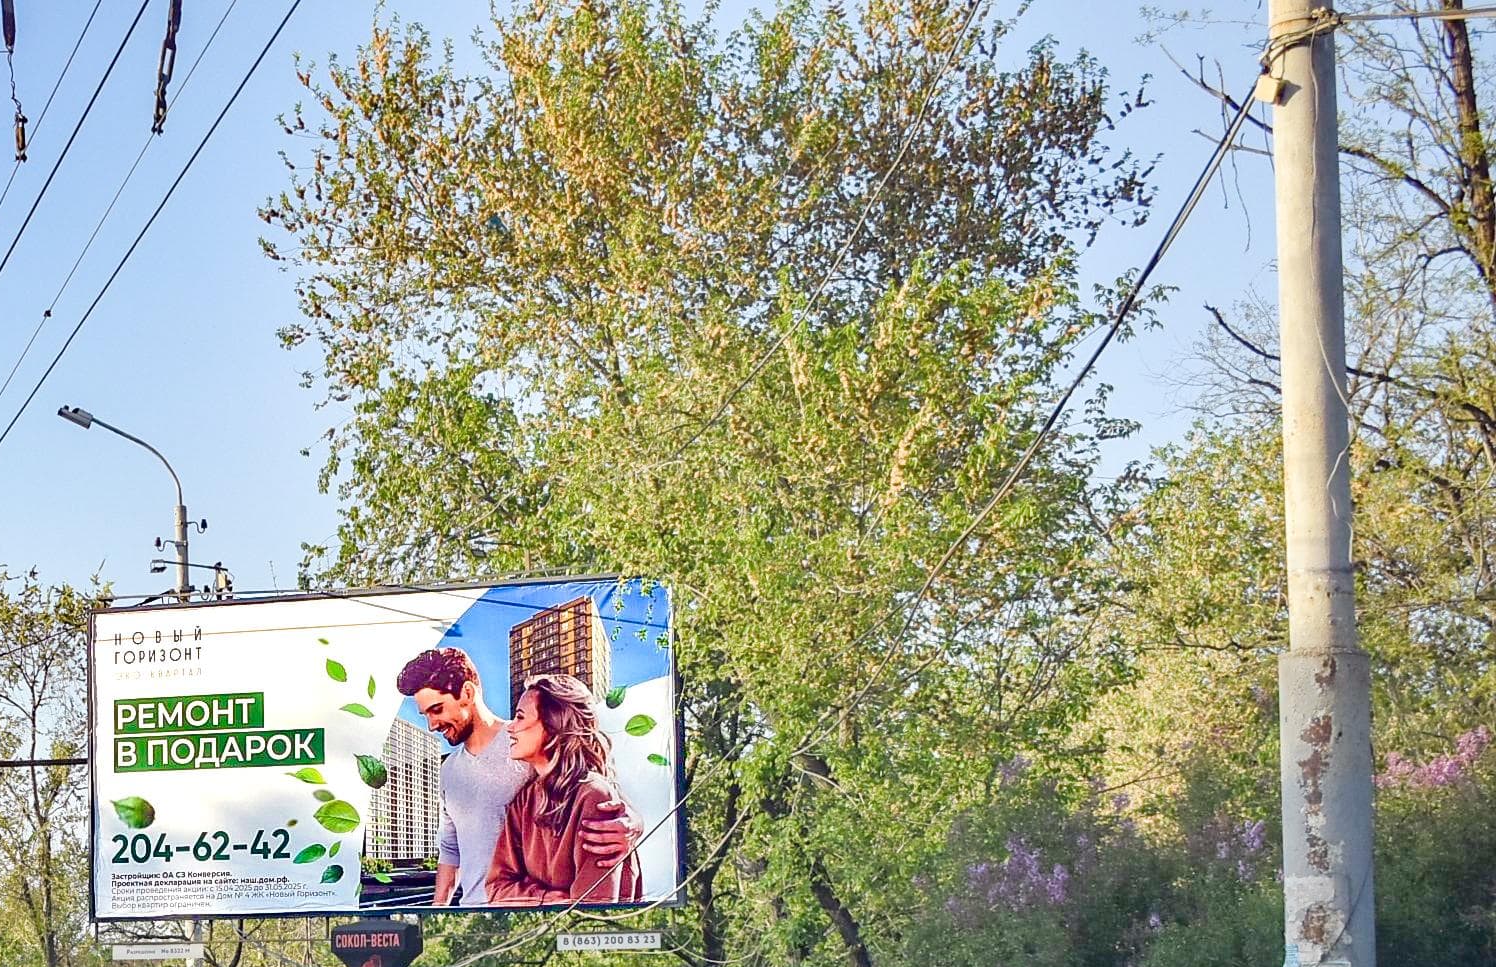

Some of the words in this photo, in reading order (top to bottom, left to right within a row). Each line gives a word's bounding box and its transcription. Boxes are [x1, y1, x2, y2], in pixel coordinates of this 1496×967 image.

[114, 626, 202, 645] НОВЫЙ
[114, 647, 202, 664] ГОРИЗОНТ
[117, 698, 255, 730] РЕМОНТ
[117, 741, 137, 767] В
[147, 732, 315, 768] ПОДАРОК
[111, 829, 291, 863] 204-62-42
[111, 880, 153, 888] Проектная
[335, 933, 400, 948] СОКОЛ-ВЕСТА
[563, 937, 569, 945] 8
[572, 936, 601, 946] (863)
[604, 936, 624, 944] 200
[627, 936, 640, 944] 83
[643, 935, 656, 943] 23
